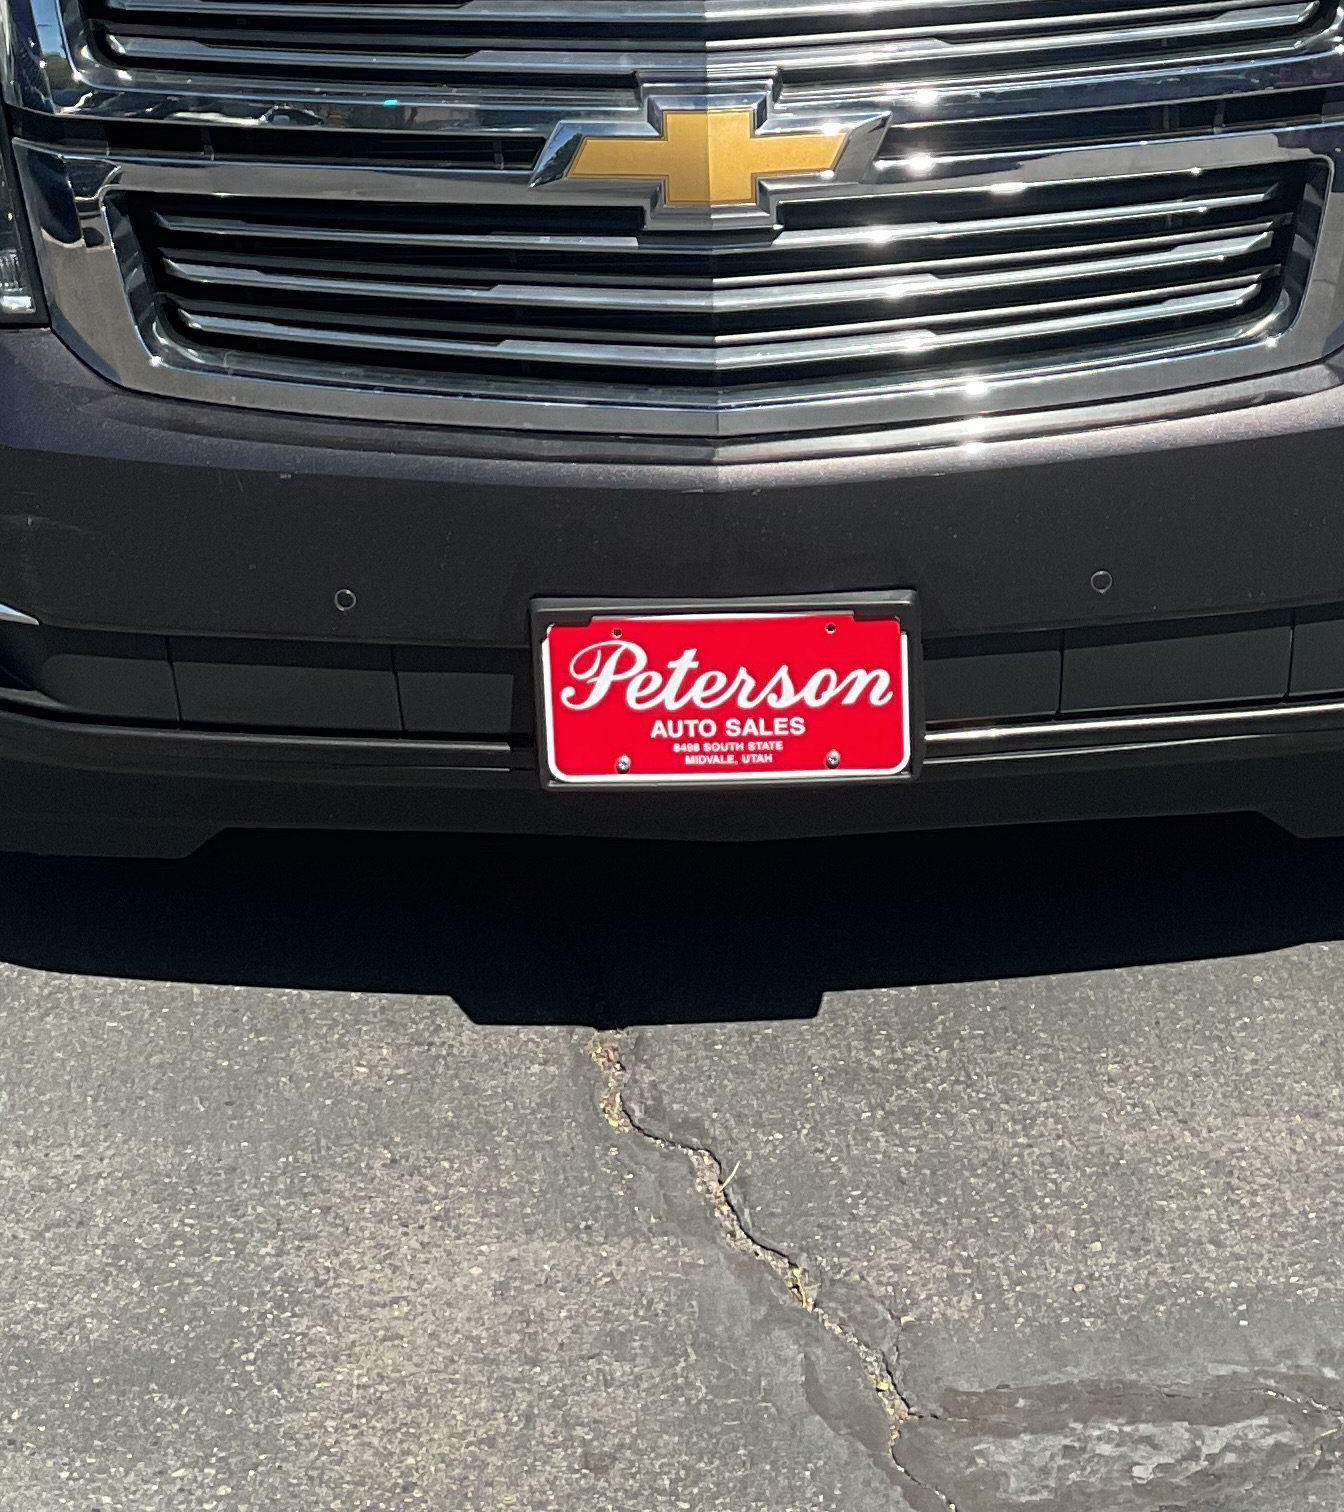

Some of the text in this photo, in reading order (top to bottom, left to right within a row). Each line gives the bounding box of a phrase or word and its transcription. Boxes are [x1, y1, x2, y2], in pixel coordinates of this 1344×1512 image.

[560, 639, 894, 711] Peterson
[650, 717, 806, 738] AUTO SALES
[703, 742, 744, 753] SOUTH
[748, 740, 784, 751] STATE
[685, 753, 773, 766] MIDVALE, UTAH
